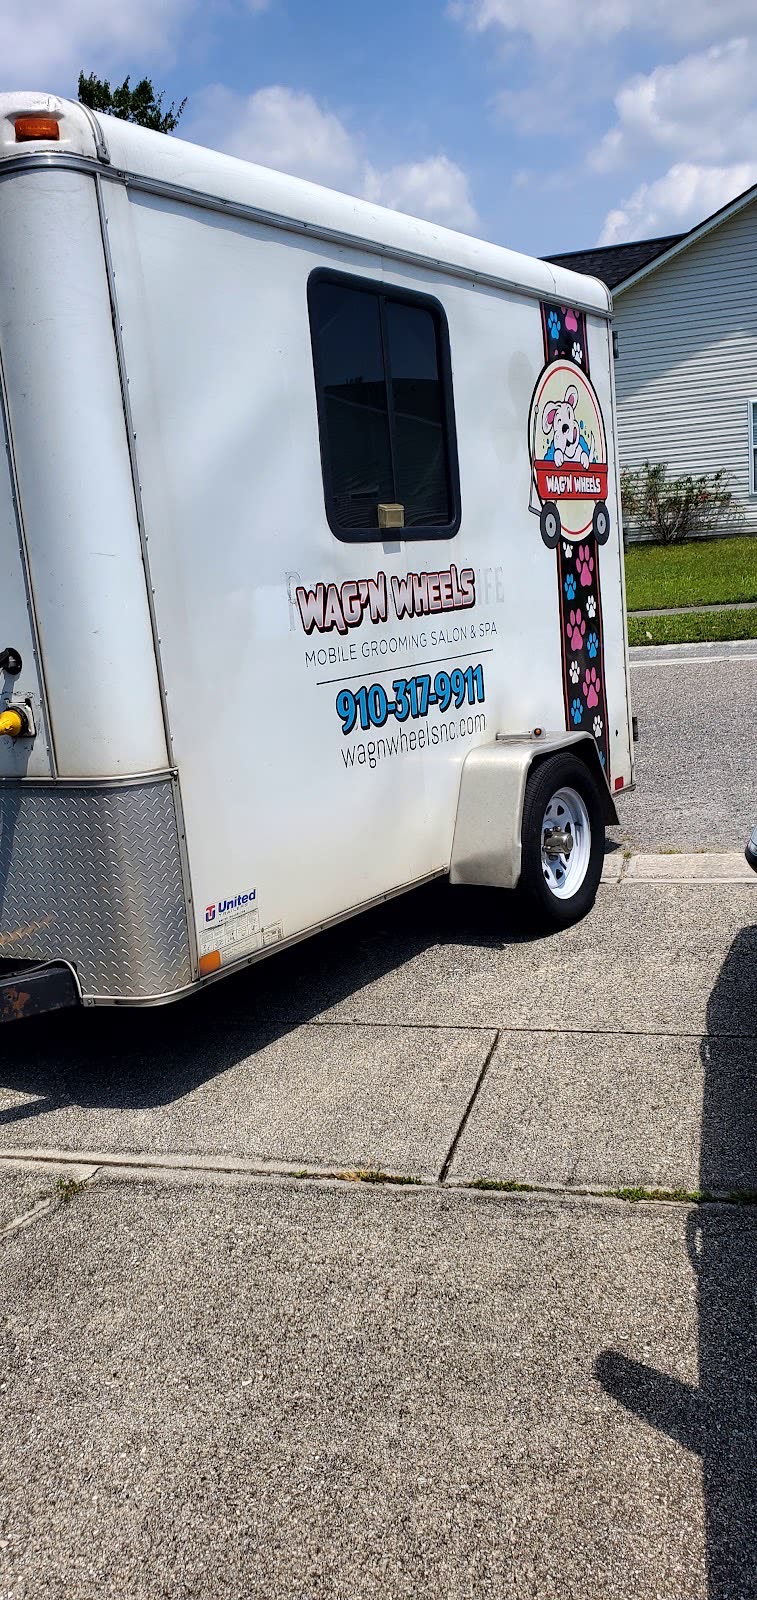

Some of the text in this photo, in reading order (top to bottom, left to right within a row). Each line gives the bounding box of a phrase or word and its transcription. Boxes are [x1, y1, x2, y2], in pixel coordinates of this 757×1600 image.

[545, 474, 602, 496] WAG'N WHEELS
[296, 570, 387, 635] WAG'N
[390, 564, 475, 620] WHEELS
[305, 621, 498, 668] MOBILE GROOMING SALON & SPA
[336, 664, 486, 735] 910-317-9911
[341, 713, 487, 769] wagnwheelsnc.com
[218, 889, 256, 913] United
